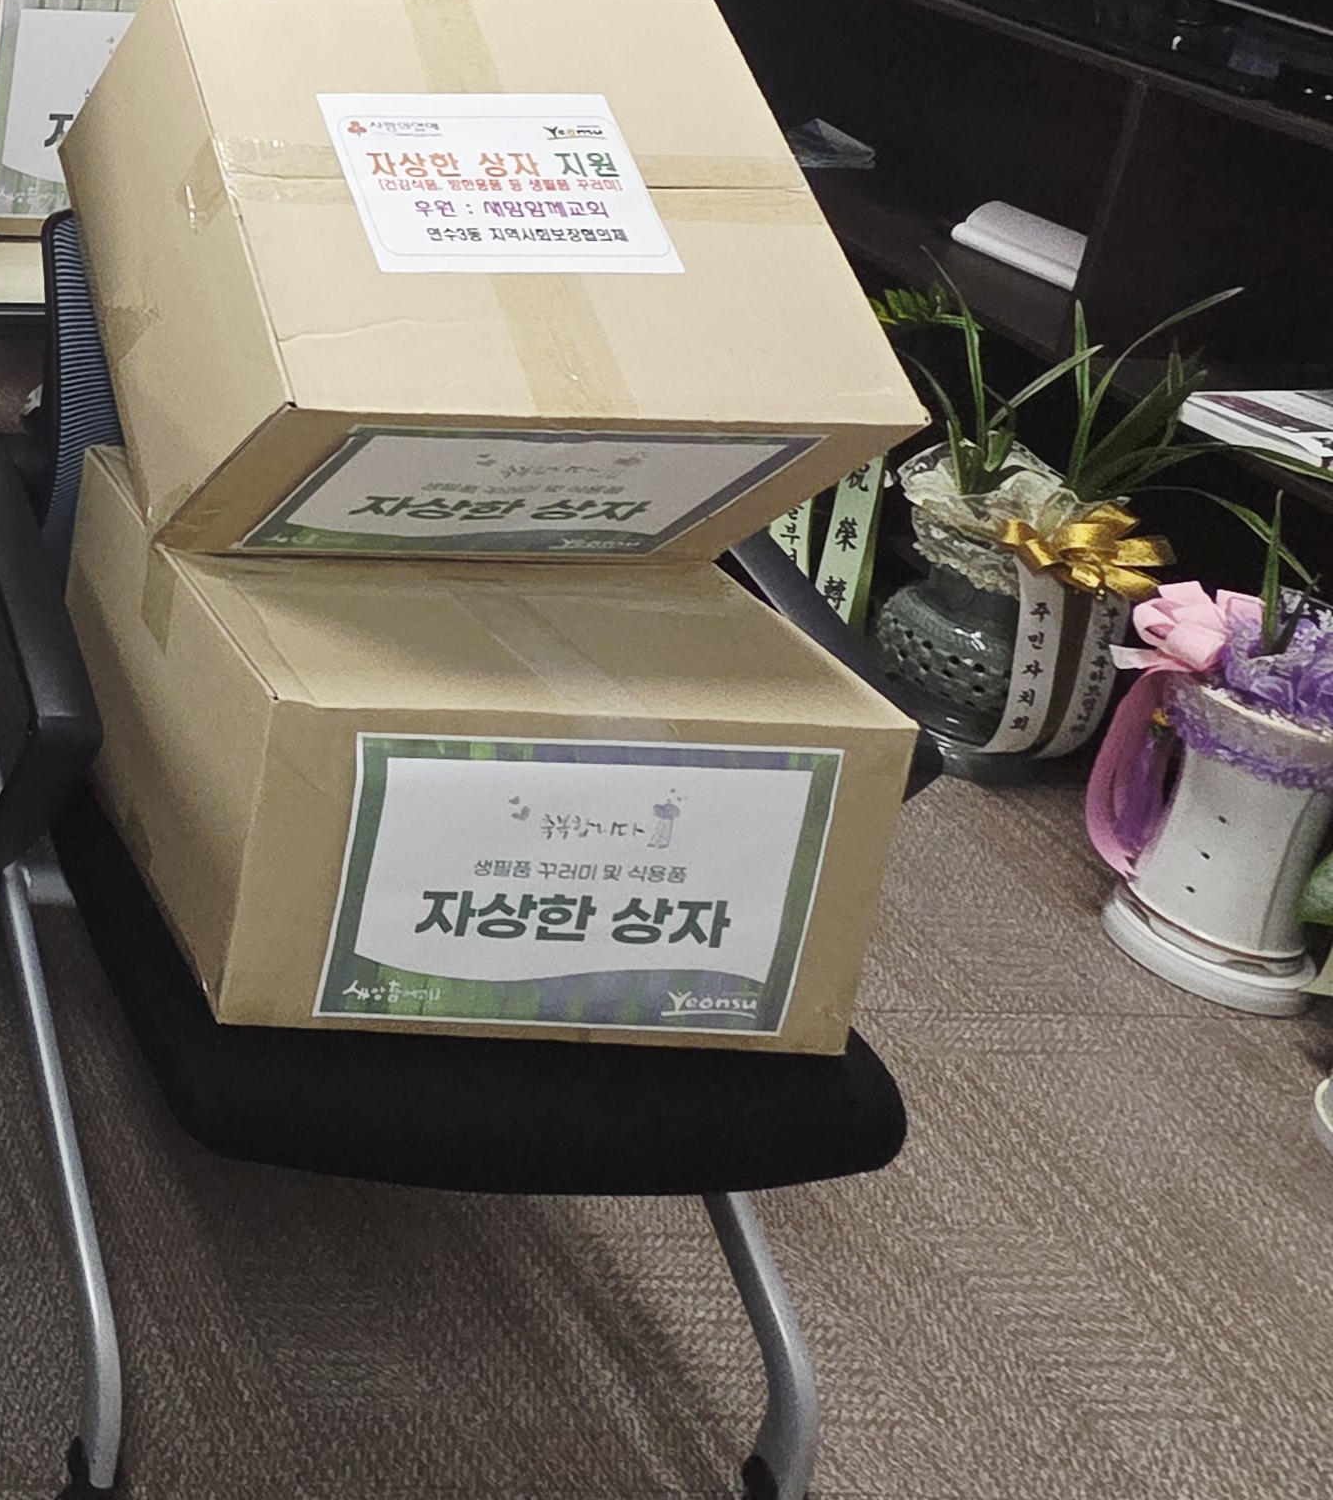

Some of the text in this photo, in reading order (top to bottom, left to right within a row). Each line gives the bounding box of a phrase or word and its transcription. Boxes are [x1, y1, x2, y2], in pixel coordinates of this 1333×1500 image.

[366, 153, 620, 177] 자상한 상자 지원
[427, 228, 481, 242] 연수3동
[348, 494, 653, 522] 자상한 상자
[473, 859, 687, 884] 생필품 꾸러미 및 식용품
[414, 890, 732, 948] 자상한 상자
[667, 990, 758, 1012] Yeonsu
